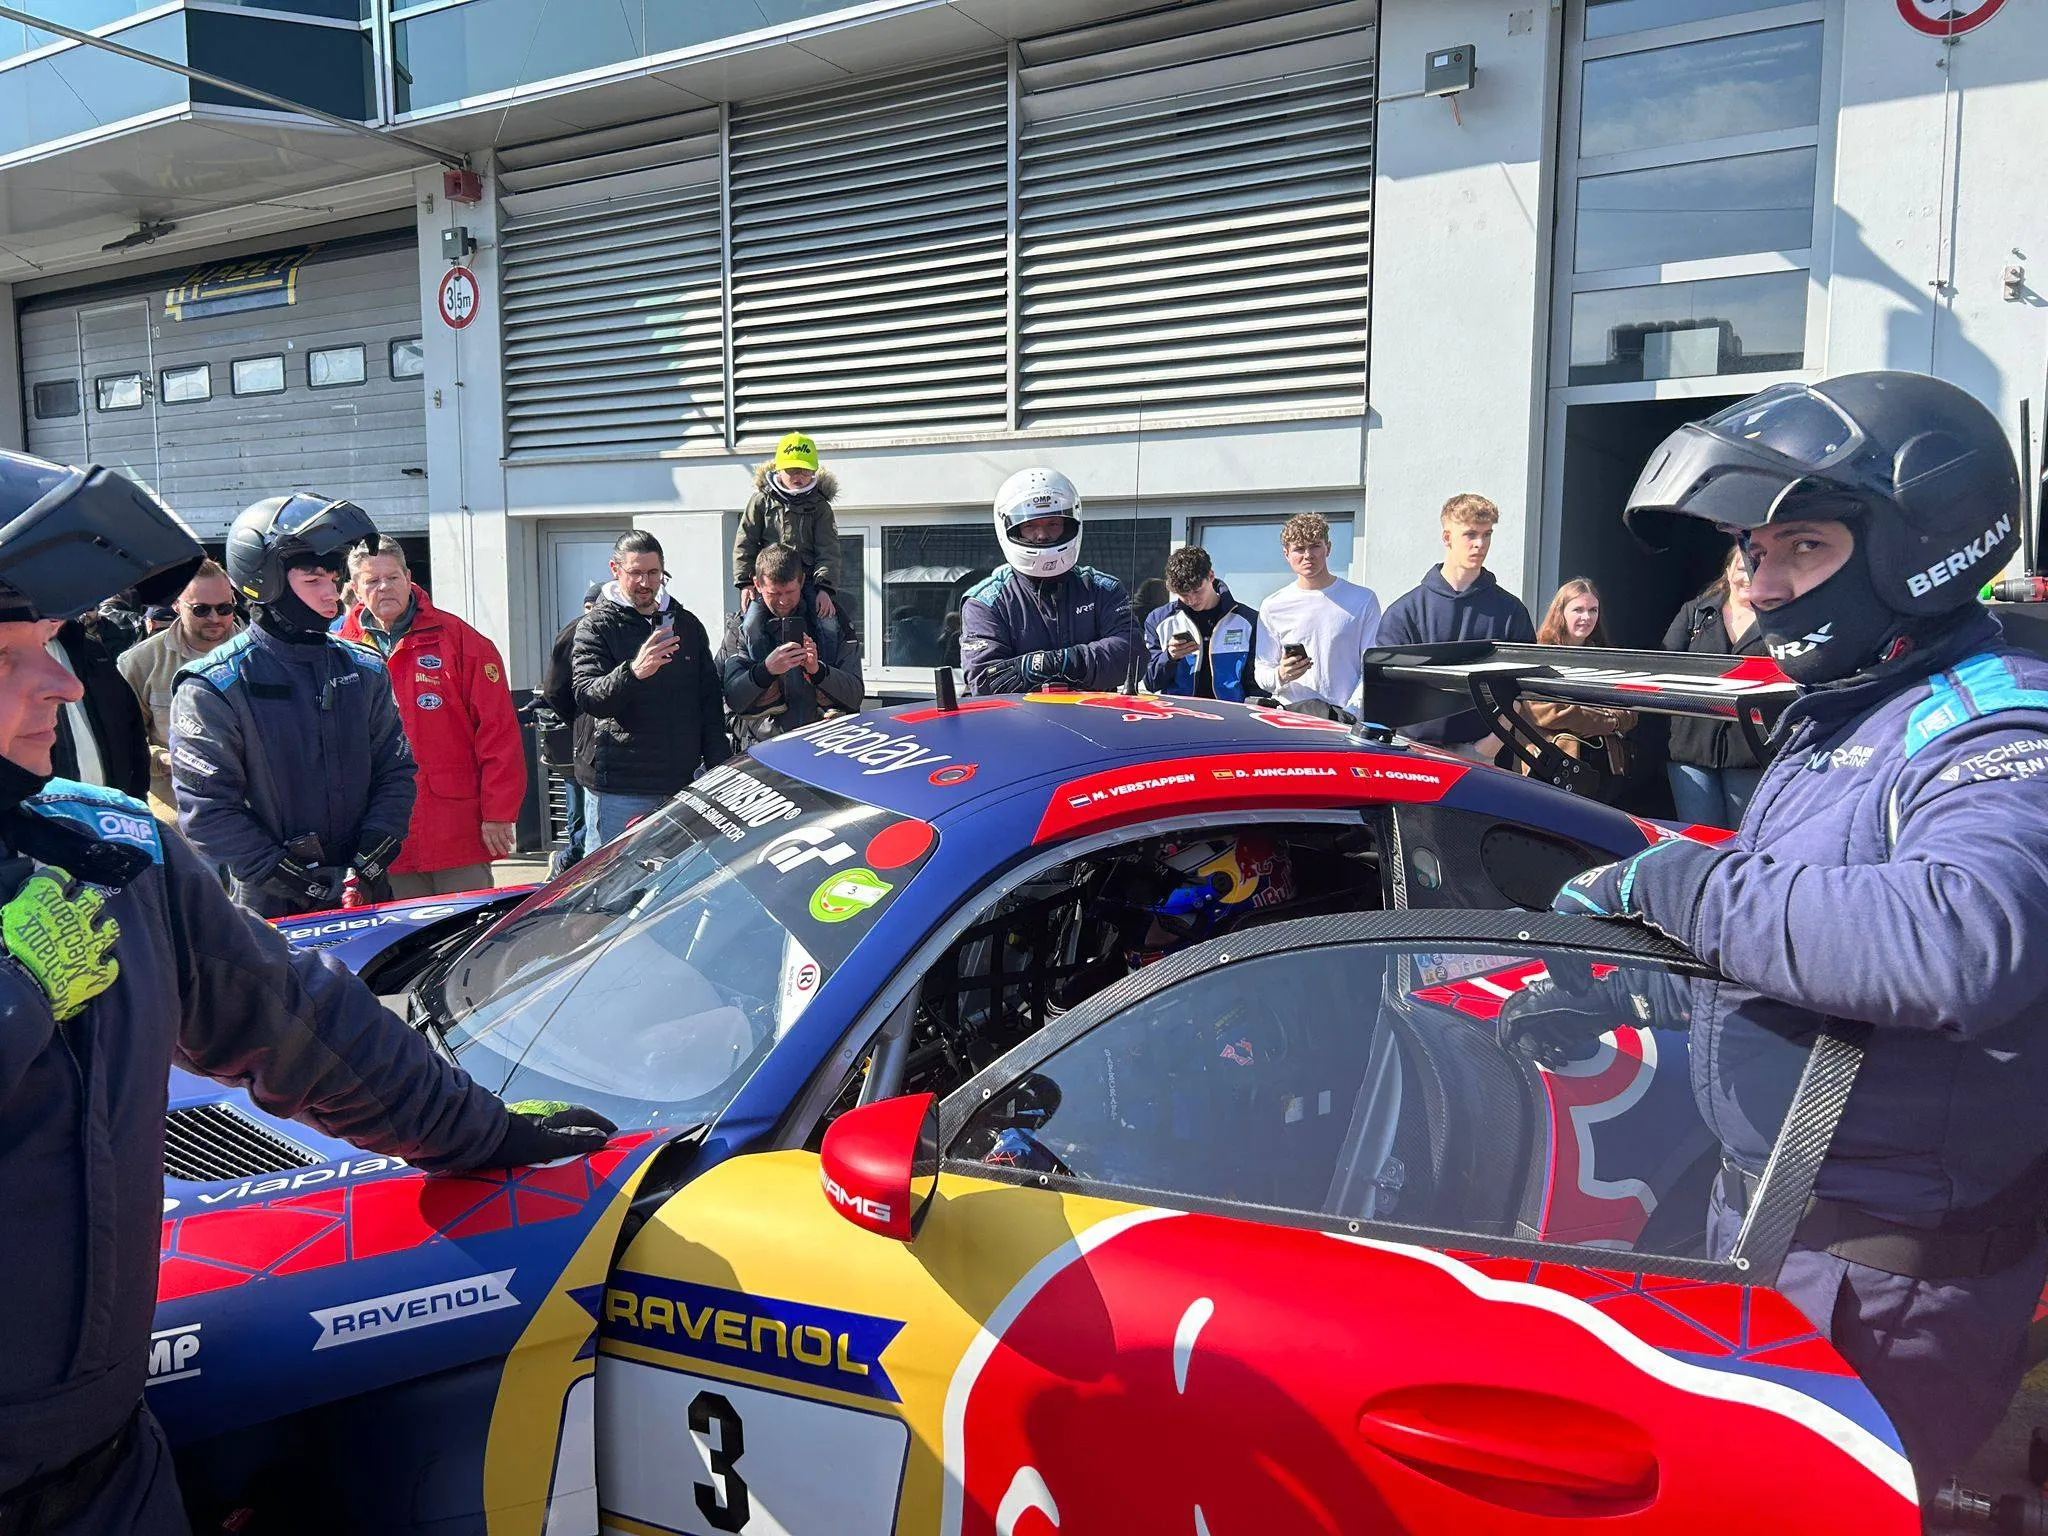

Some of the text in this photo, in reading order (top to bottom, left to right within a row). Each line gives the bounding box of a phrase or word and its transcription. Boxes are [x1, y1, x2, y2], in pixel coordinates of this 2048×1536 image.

[1033, 495, 1051, 503] OMP
[1906, 513, 2012, 598] BERKAN
[178, 715, 203, 736] OMP
[802, 717, 952, 775] viaplay
[1093, 773, 1196, 801] M. VERSTAPPEN
[1236, 767, 1337, 778] D. JUNCADELLA
[1374, 770, 1440, 784] J. GOUNON
[100, 815, 153, 839] OMP
[702, 807, 746, 843] SIMULATOR
[826, 1181, 891, 1223] AMG
[333, 1285, 500, 1336] RAVENOL
[605, 1287, 869, 1376] RAVENOL
[148, 1334, 200, 1377] MP
[687, 1389, 751, 1534] 3
